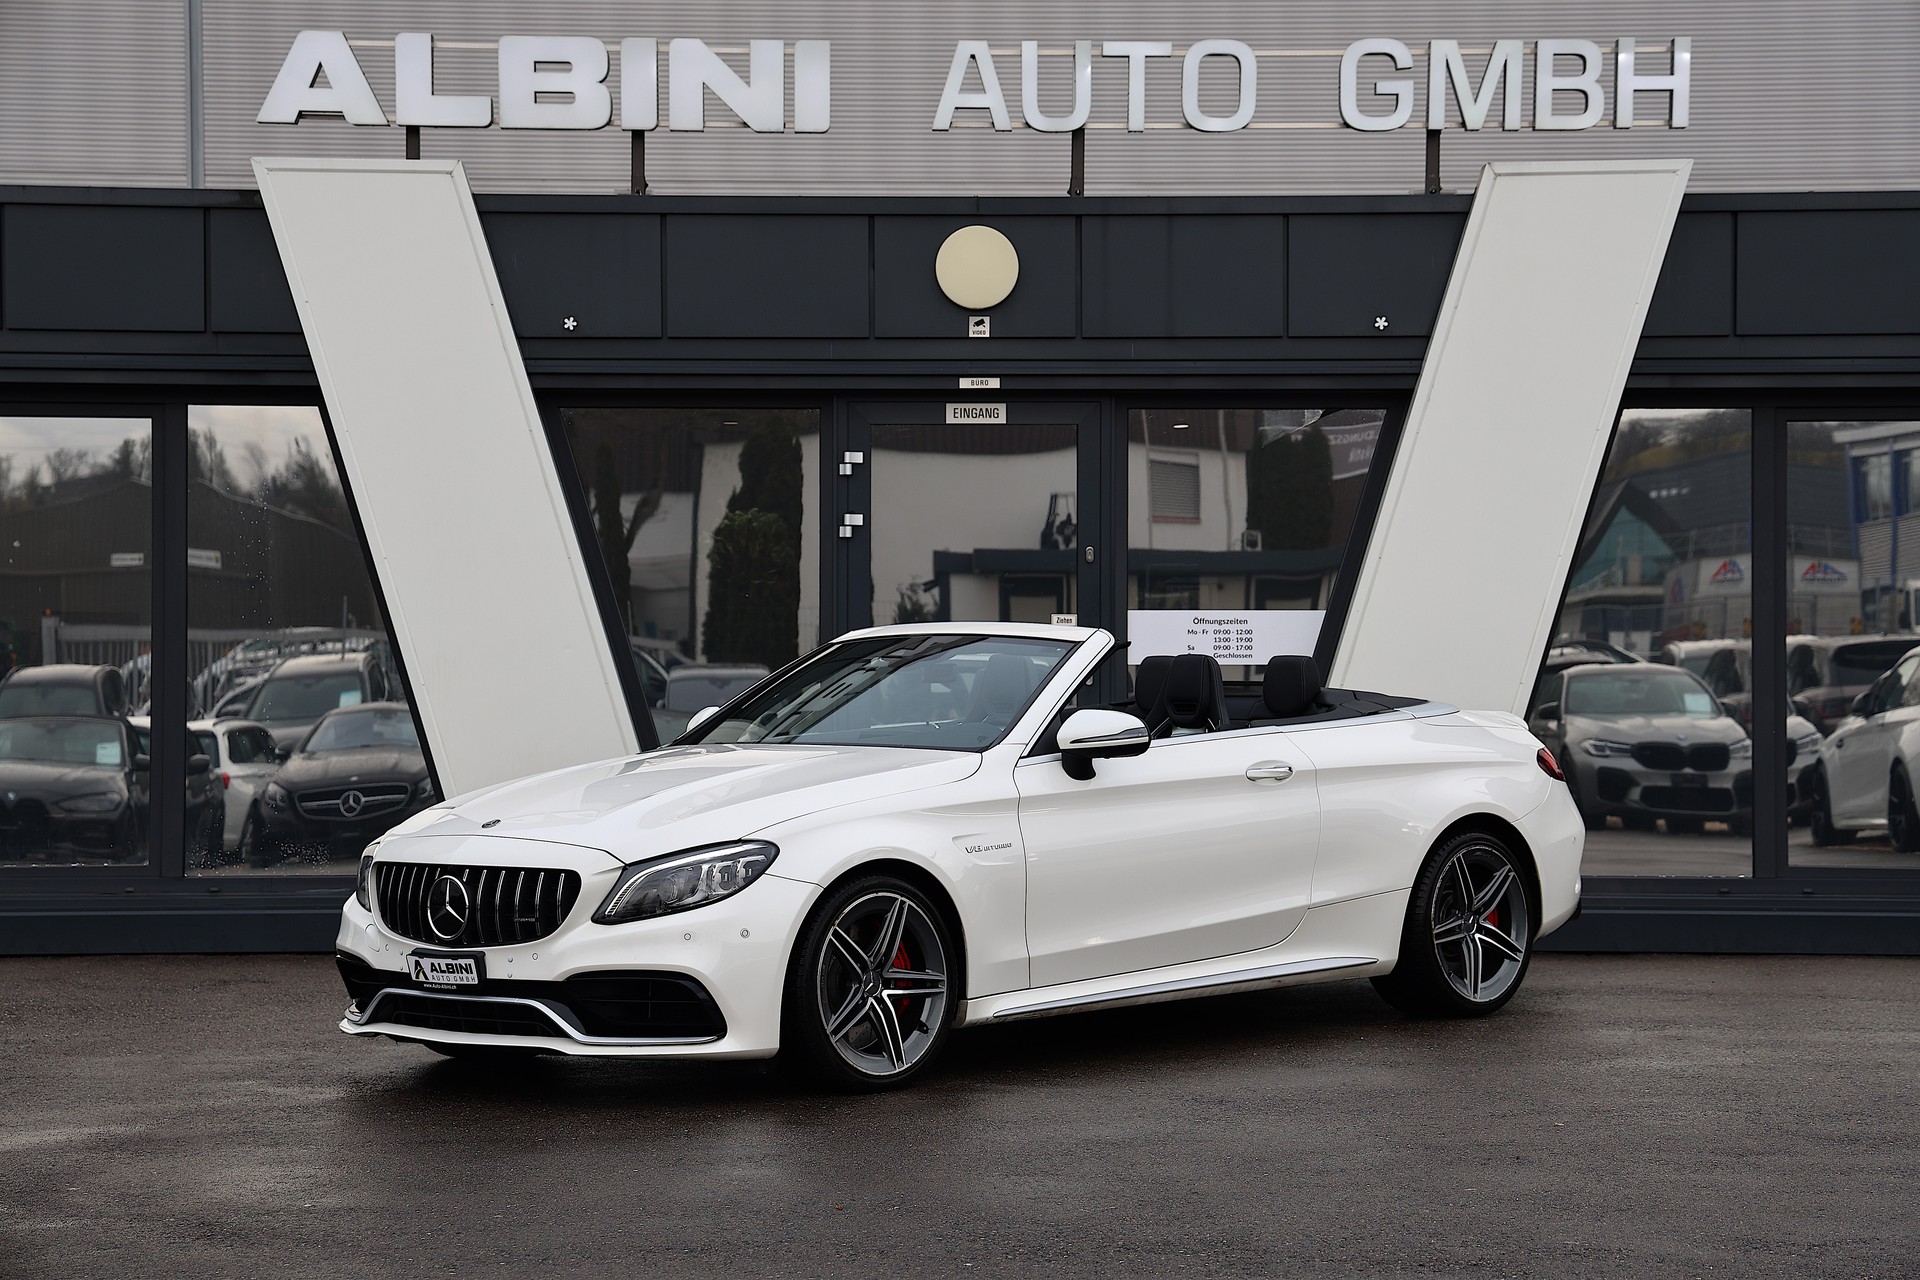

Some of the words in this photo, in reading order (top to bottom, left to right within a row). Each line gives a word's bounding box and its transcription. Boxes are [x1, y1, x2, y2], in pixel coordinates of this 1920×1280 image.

[256, 30, 831, 133] ALBINI
[932, 39, 1257, 133] AUTO
[1339, 36, 1692, 132] GMBH
[953, 407, 1000, 419] EINGANG
[1056, 616, 1073, 624] Ziehen
[1193, 616, 1248, 626] Öffnungszeiten
[430, 962, 474, 975] ALBINI
